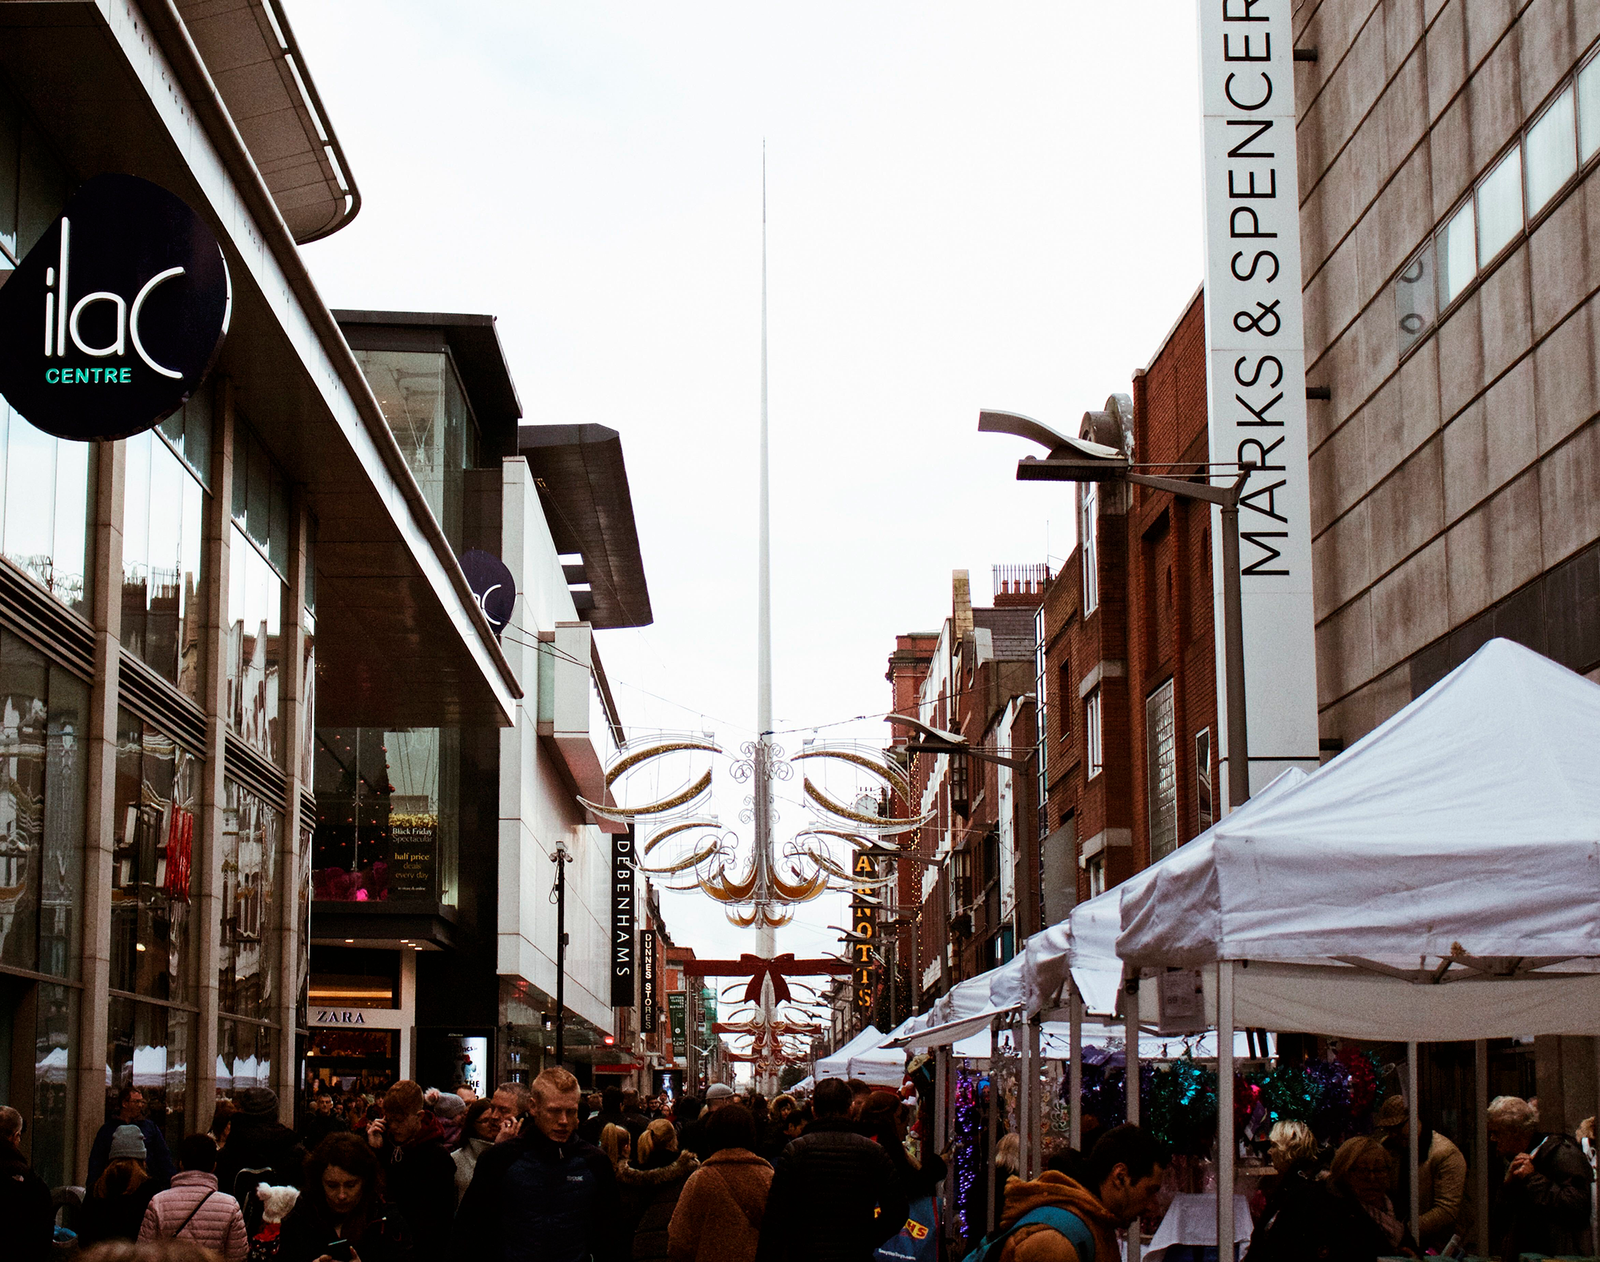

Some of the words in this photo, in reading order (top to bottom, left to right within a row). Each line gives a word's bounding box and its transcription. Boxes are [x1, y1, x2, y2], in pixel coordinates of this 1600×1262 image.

[1222, 0, 1280, 284] SPENCER
[1232, 298, 1282, 338] &
[45, 366, 133, 385] CENTRE
[1233, 354, 1291, 577] MARKS
[392, 827, 411, 836] Black
[412, 827, 433, 837] Friday
[392, 834, 434, 844] Spectacular
[394, 852, 410, 861] half
[410, 852, 431, 863] price
[616, 840, 631, 977] DEBENHAMS
[644, 933, 653, 980] DUNNES
[316, 1010, 366, 1023] ZARA
[644, 982, 653, 1030] STORES
